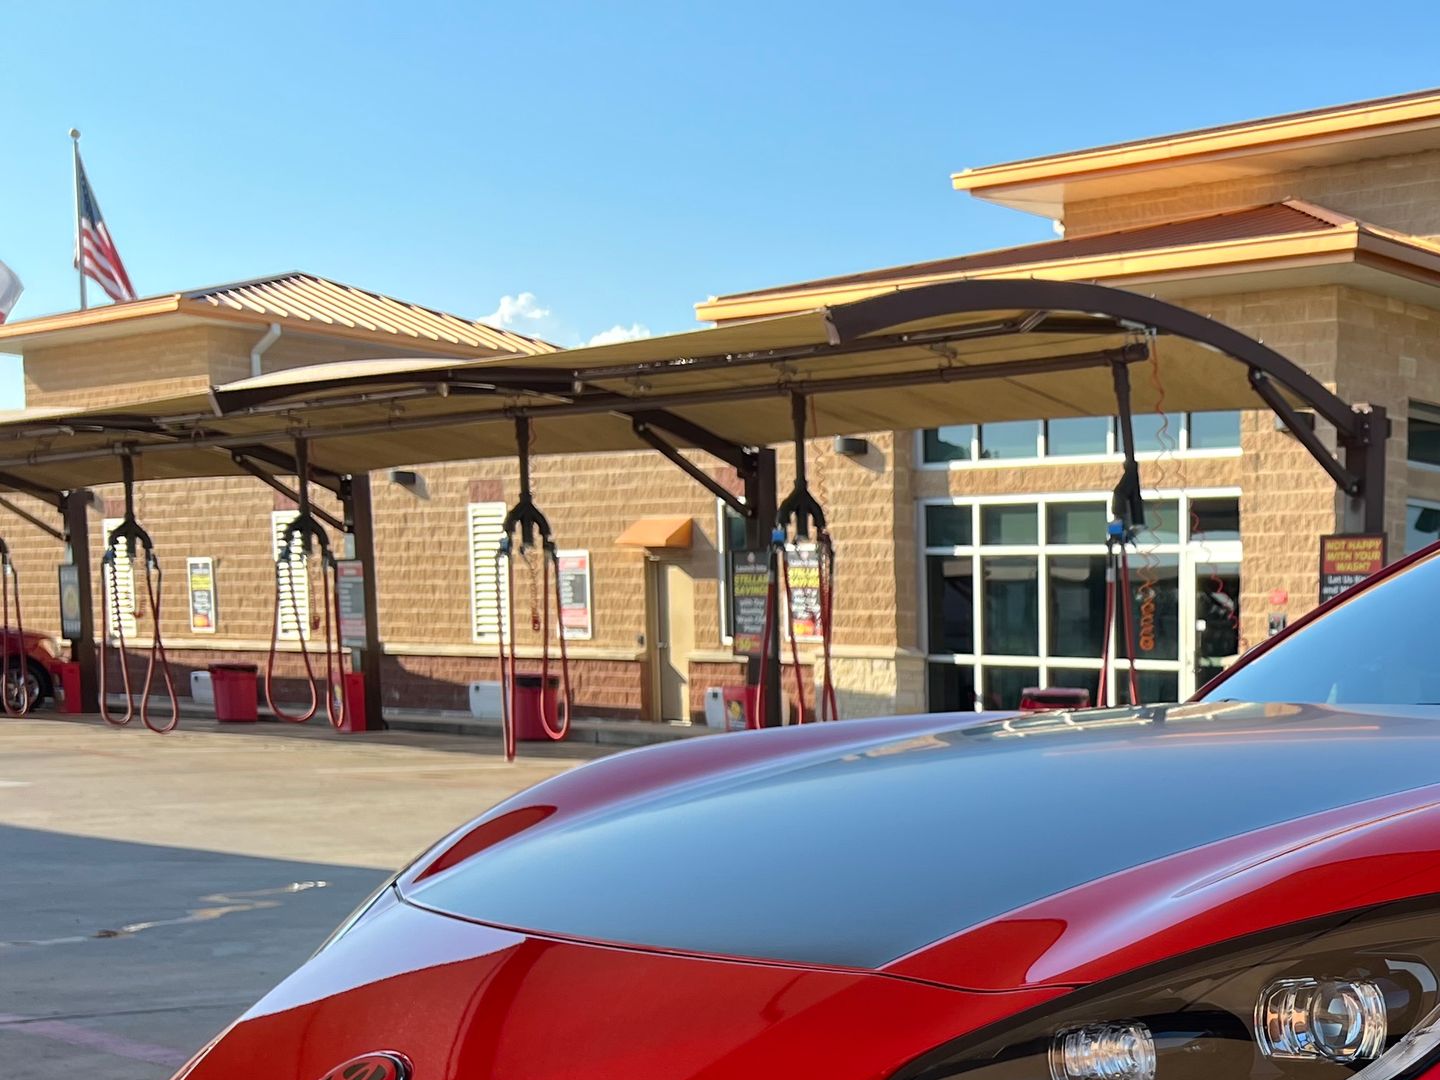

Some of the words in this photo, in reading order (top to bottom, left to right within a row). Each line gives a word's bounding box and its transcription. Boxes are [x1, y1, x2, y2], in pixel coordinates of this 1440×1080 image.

[1326, 541, 1345, 550] NOT
[1348, 539, 1382, 549] HAPPY
[1327, 551, 1353, 561] WITH
[1355, 550, 1381, 560] YOUR
[1335, 562, 1371, 572] WASH?
